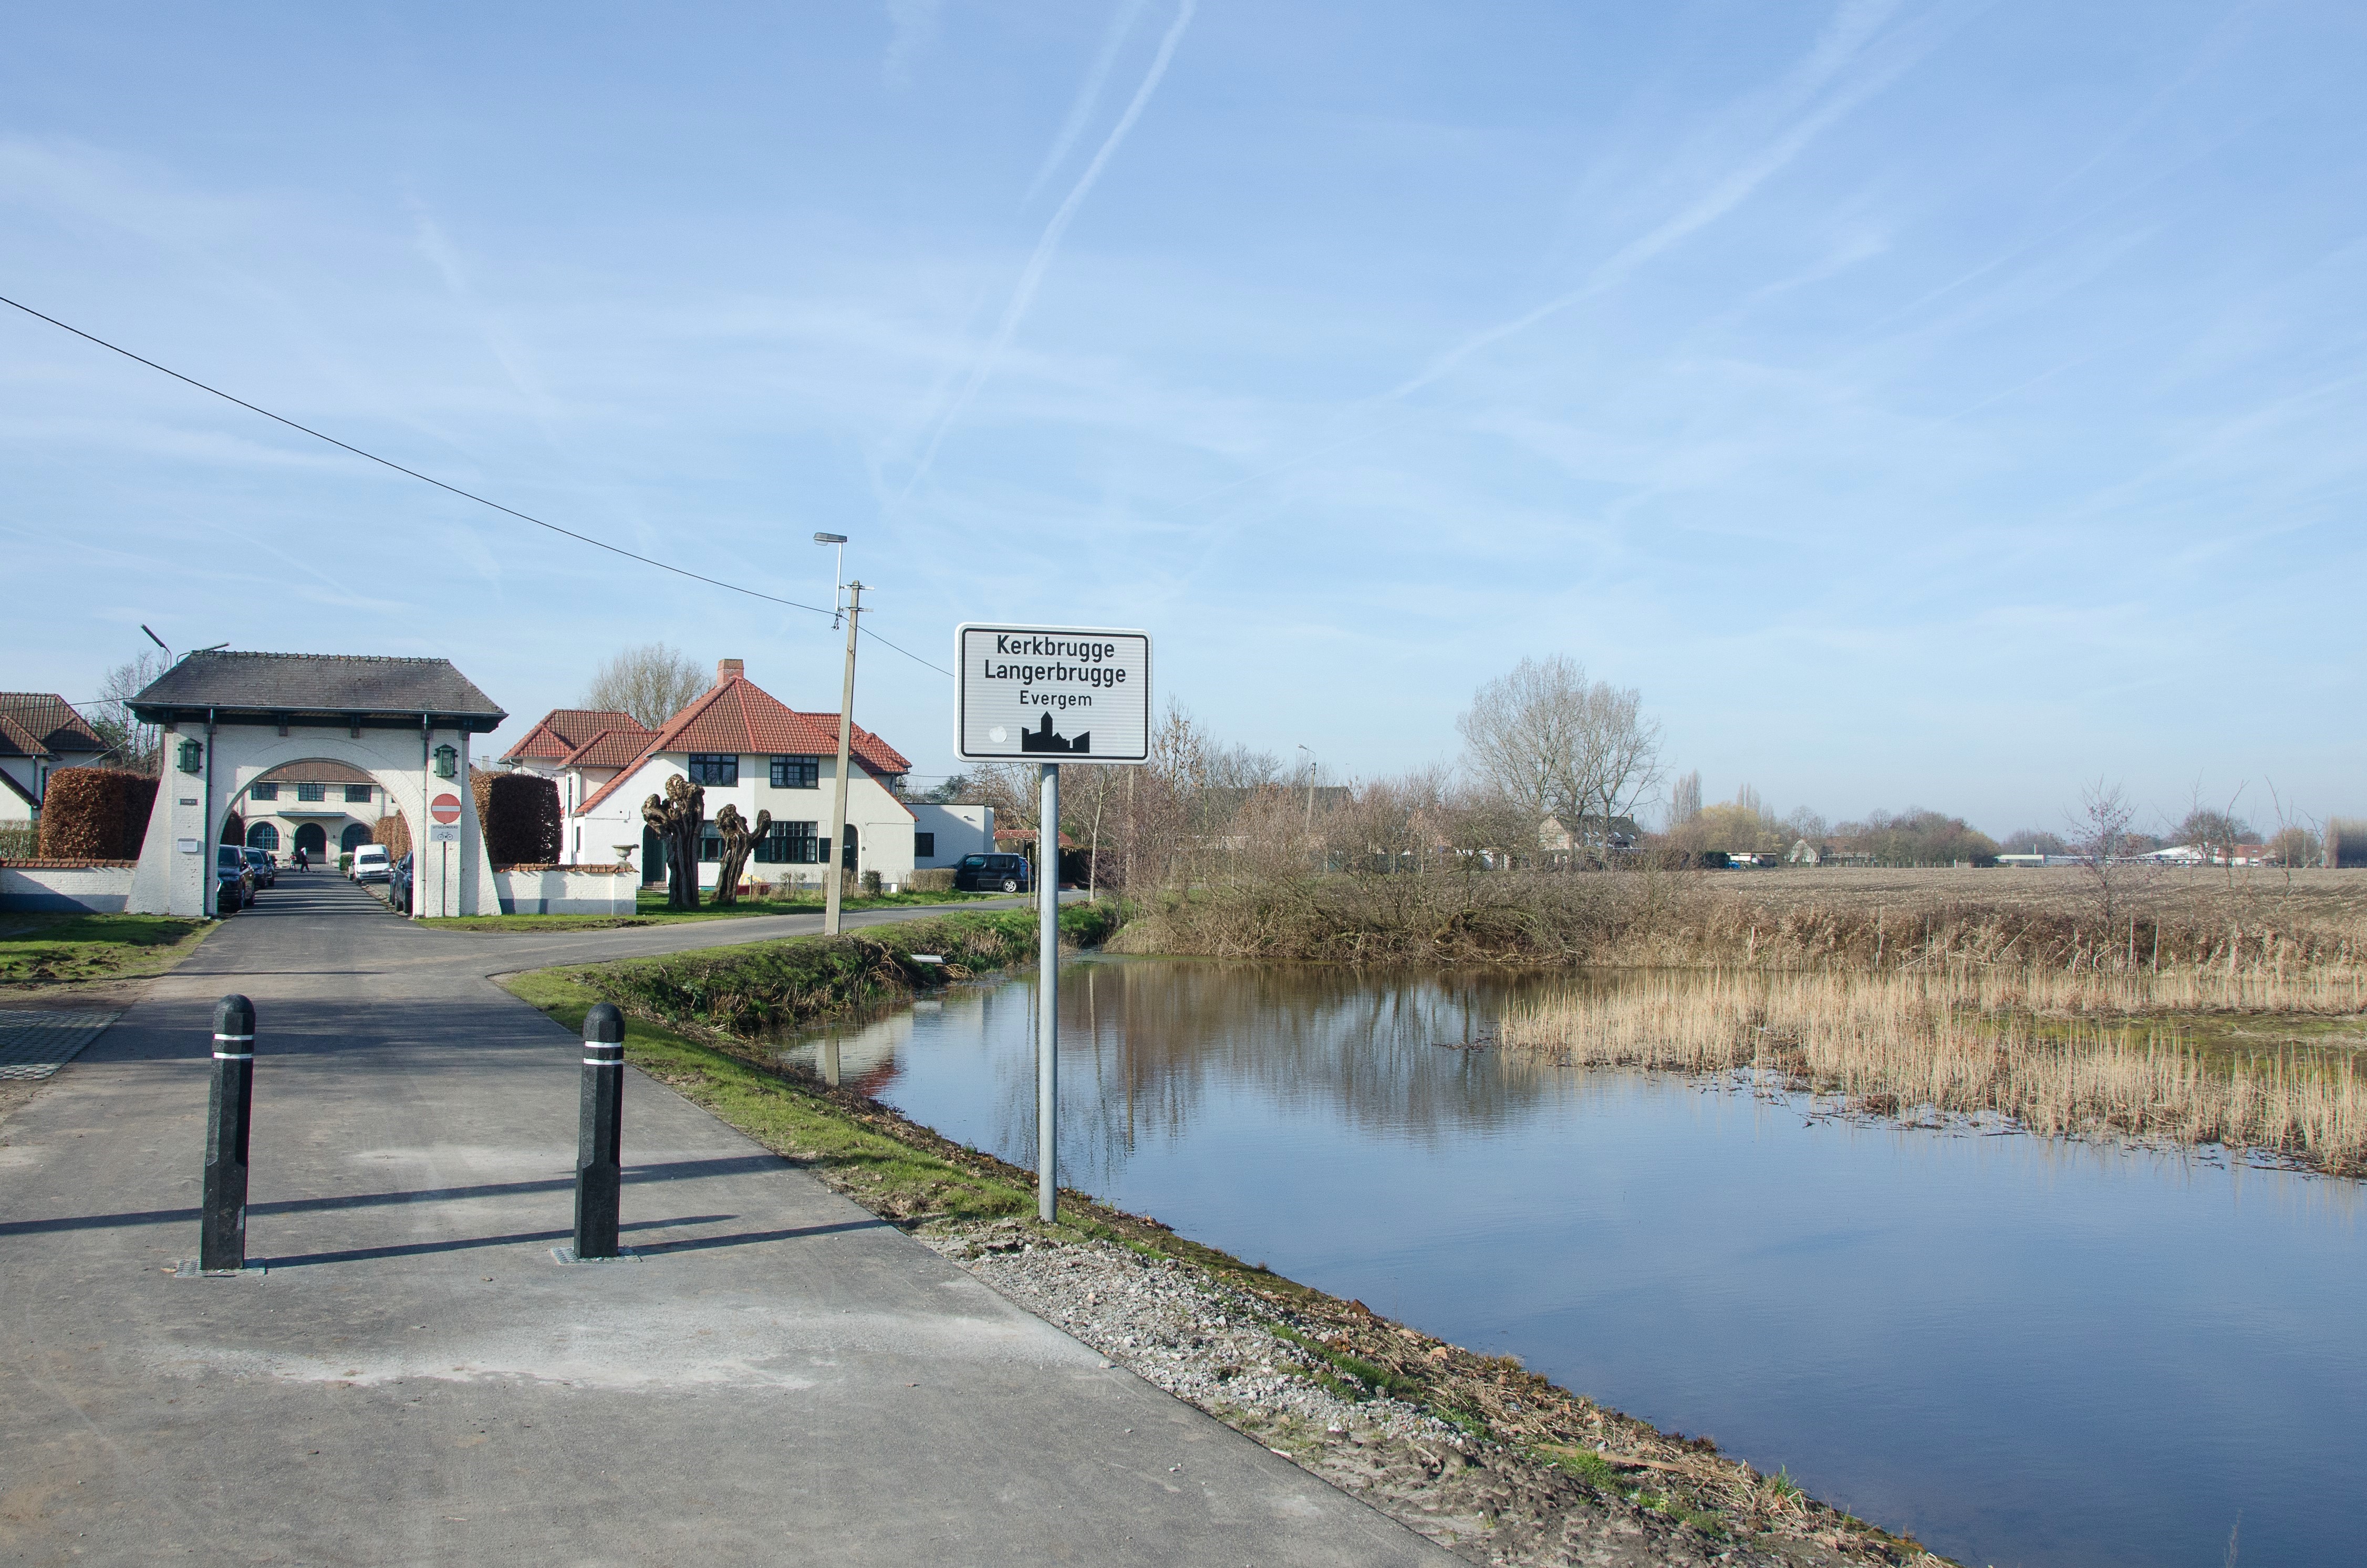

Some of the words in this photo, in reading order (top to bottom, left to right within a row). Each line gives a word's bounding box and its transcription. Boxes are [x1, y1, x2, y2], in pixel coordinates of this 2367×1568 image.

[998, 635, 1115, 663] Kerkbrugge
[985, 659, 1126, 688] Langerbrugge
[1020, 690, 1092, 710] Evergem
